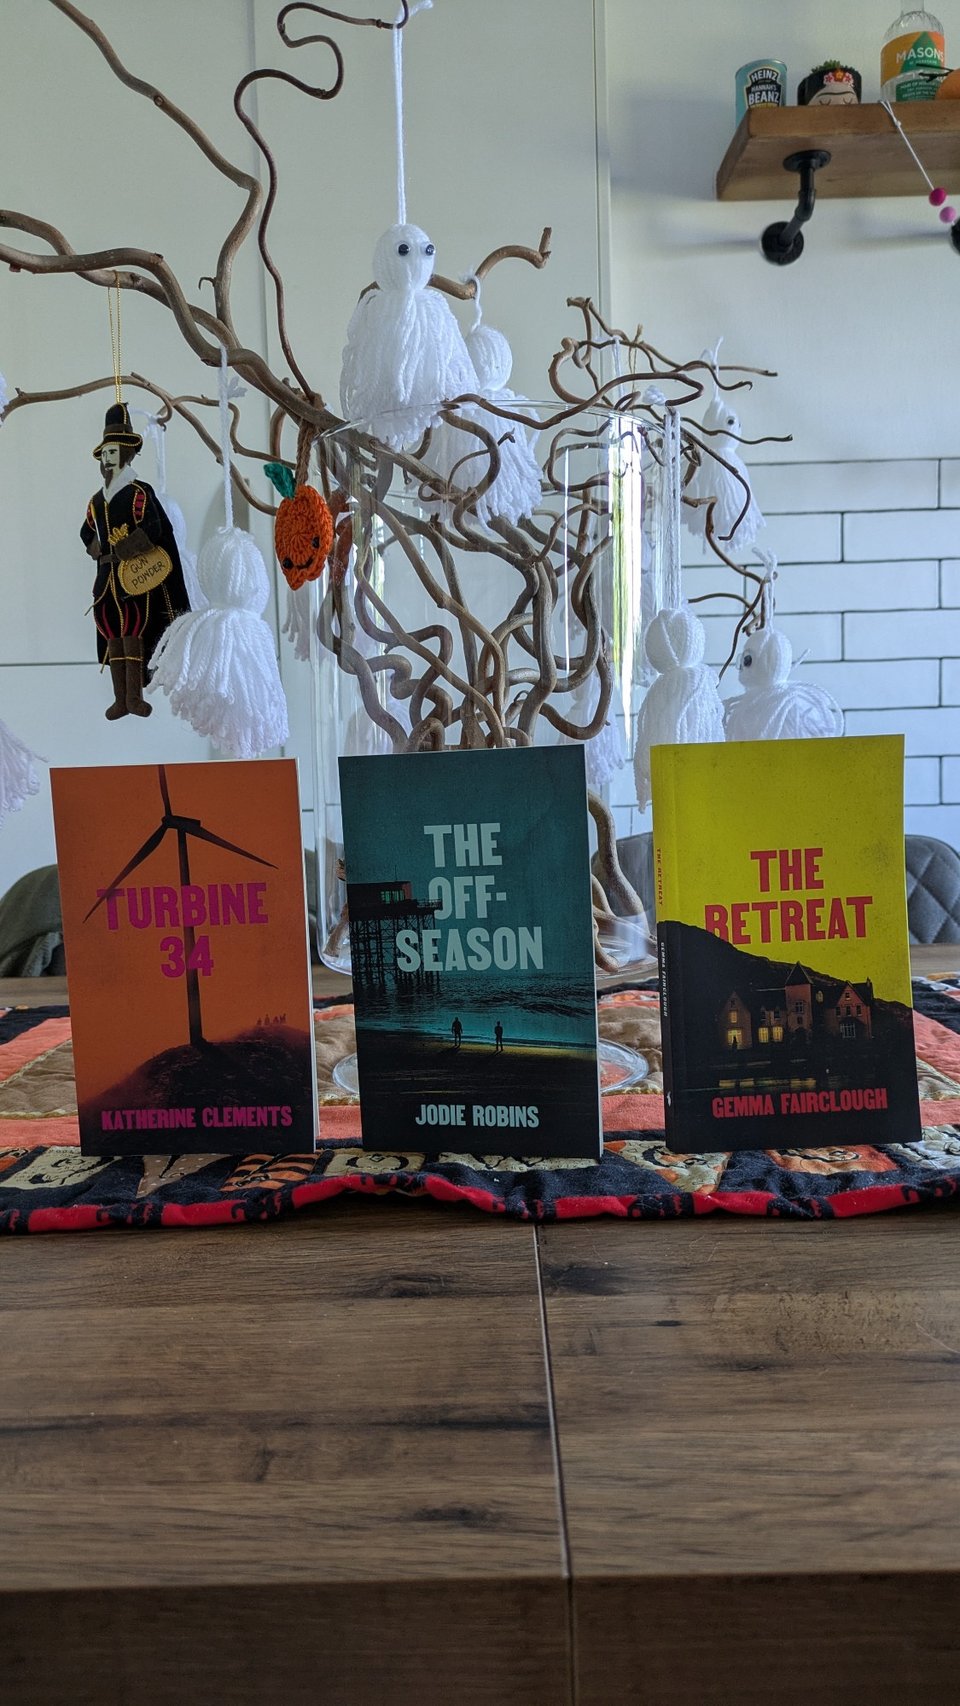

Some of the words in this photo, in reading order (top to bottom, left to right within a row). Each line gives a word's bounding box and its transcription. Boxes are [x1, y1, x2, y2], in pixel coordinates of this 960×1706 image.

[751, 70, 778, 82] HEINZ
[748, 91, 780, 105] BEANZ
[130, 555, 149, 574] GUN
[131, 561, 165, 589] POWDER
[424, 822, 503, 868] THE
[750, 848, 824, 892] THE
[97, 882, 269, 930] TURBINE
[428, 875, 507, 921] OFF-
[705, 896, 873, 945] RETREAT
[160, 935, 214, 978] 34
[395, 926, 544, 972] SEASON
[101, 1107, 197, 1131] KATHERINE
[202, 1106, 293, 1128] CLEMENTS
[415, 1104, 467, 1126] JODIE
[472, 1105, 540, 1128] ROBINS
[712, 1094, 775, 1118] GEMMA
[780, 1088, 888, 1115] FAIRCLOUGH
